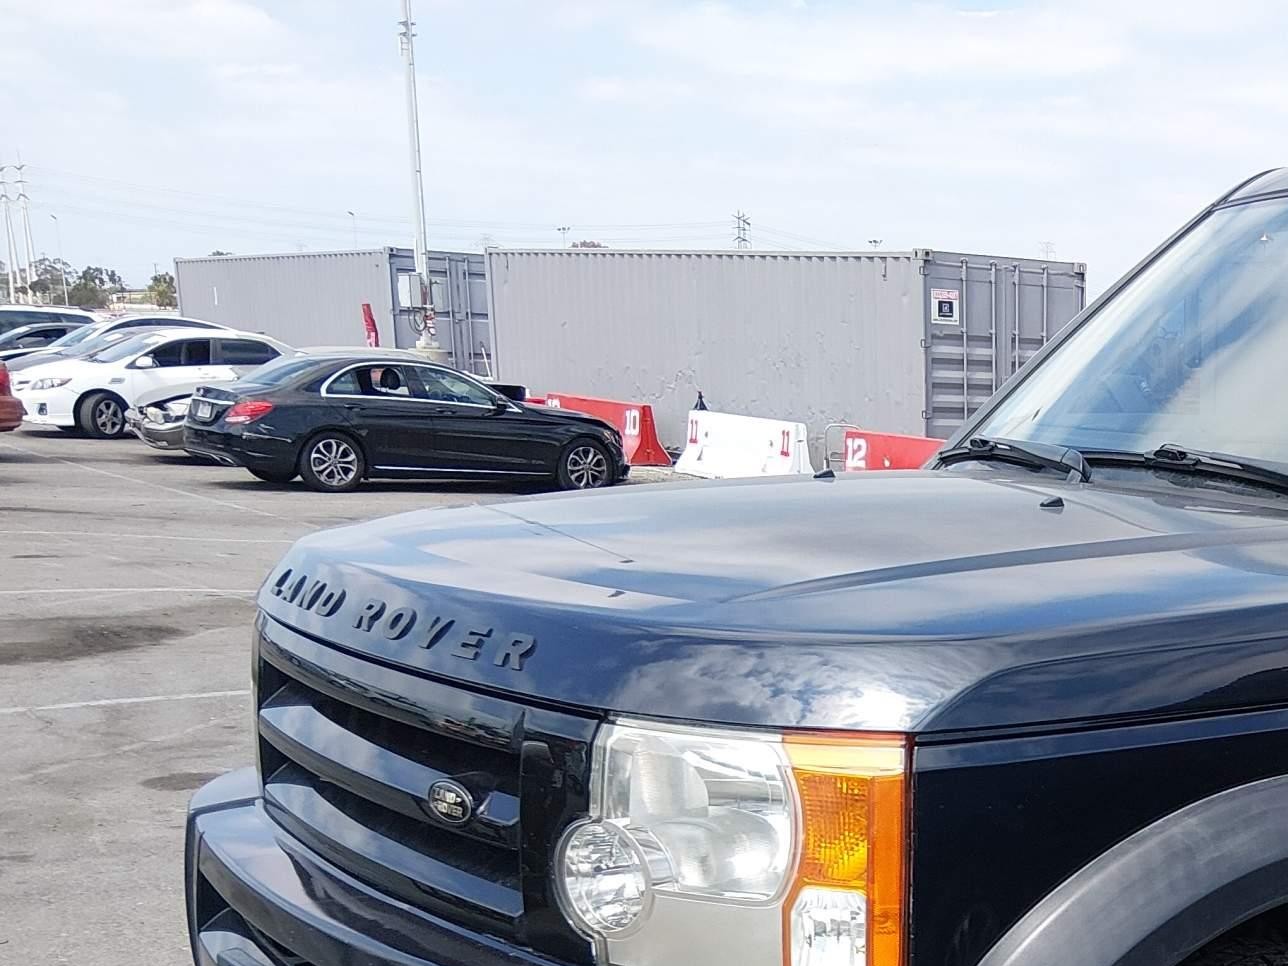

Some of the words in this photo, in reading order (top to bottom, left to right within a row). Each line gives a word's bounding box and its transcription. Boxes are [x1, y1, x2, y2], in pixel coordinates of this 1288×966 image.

[624, 408, 640, 436] 10
[688, 419, 698, 444] 11
[779, 430, 790, 457] 11
[846, 437, 867, 469] 12
[271, 568, 347, 618] LAND
[352, 598, 537, 672] ROVER
